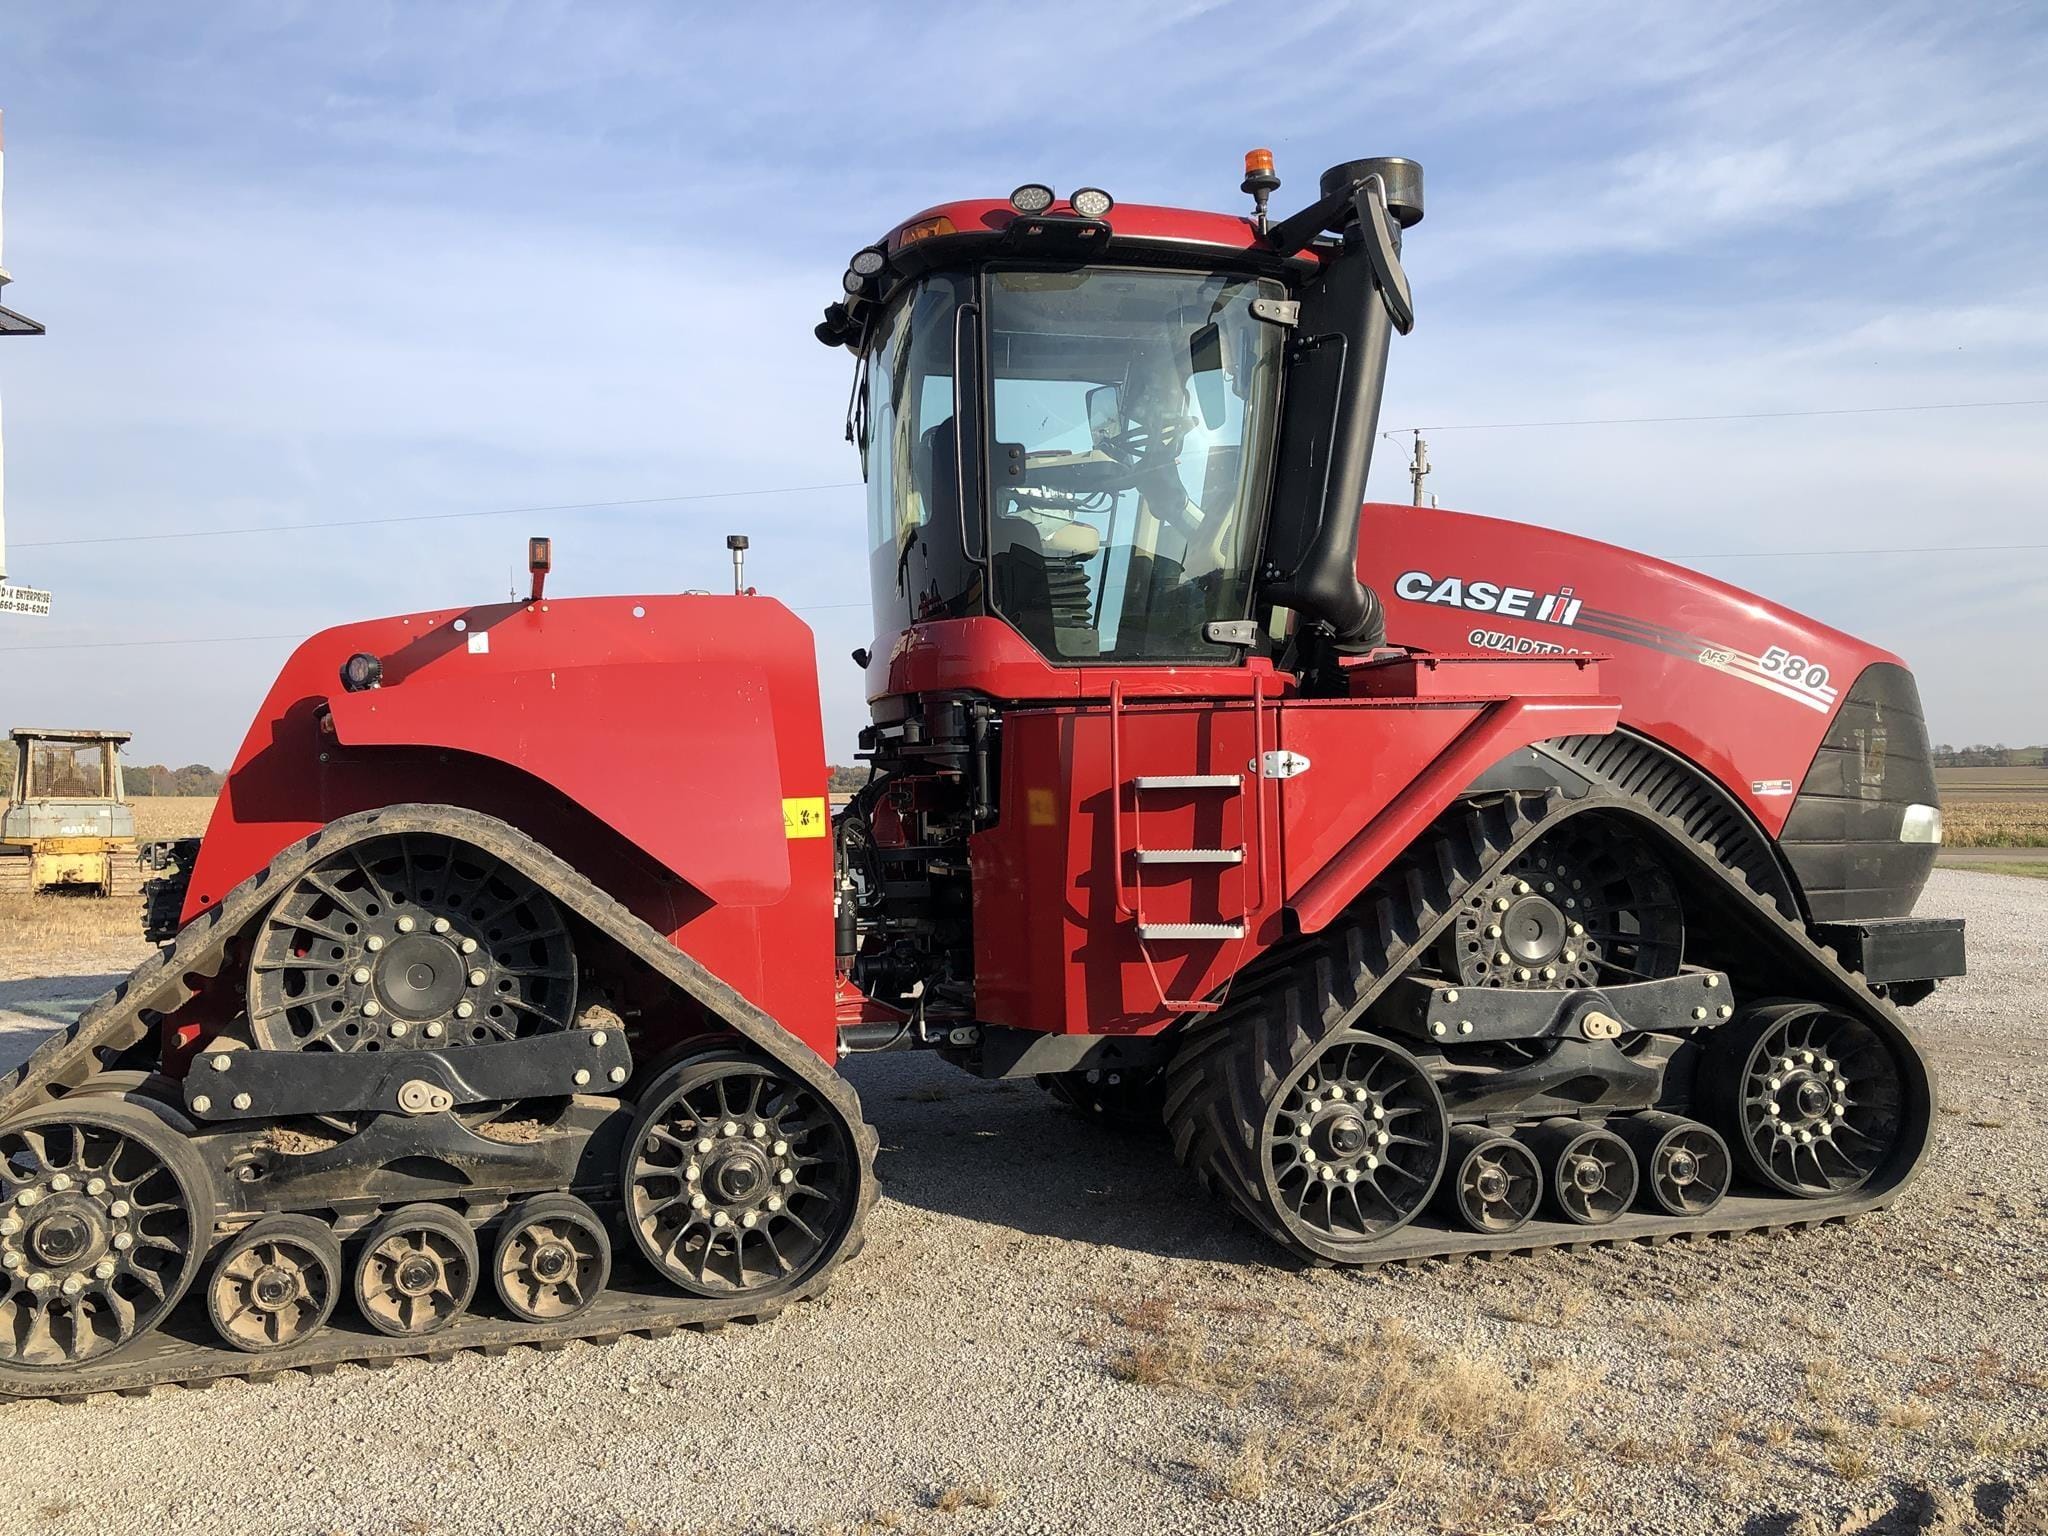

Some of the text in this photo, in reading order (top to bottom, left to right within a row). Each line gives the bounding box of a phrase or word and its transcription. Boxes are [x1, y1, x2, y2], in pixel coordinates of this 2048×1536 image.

[1395, 571, 1535, 617] CASE
[1469, 630, 1593, 655] QUADTR
[1761, 648, 1827, 689] 580
